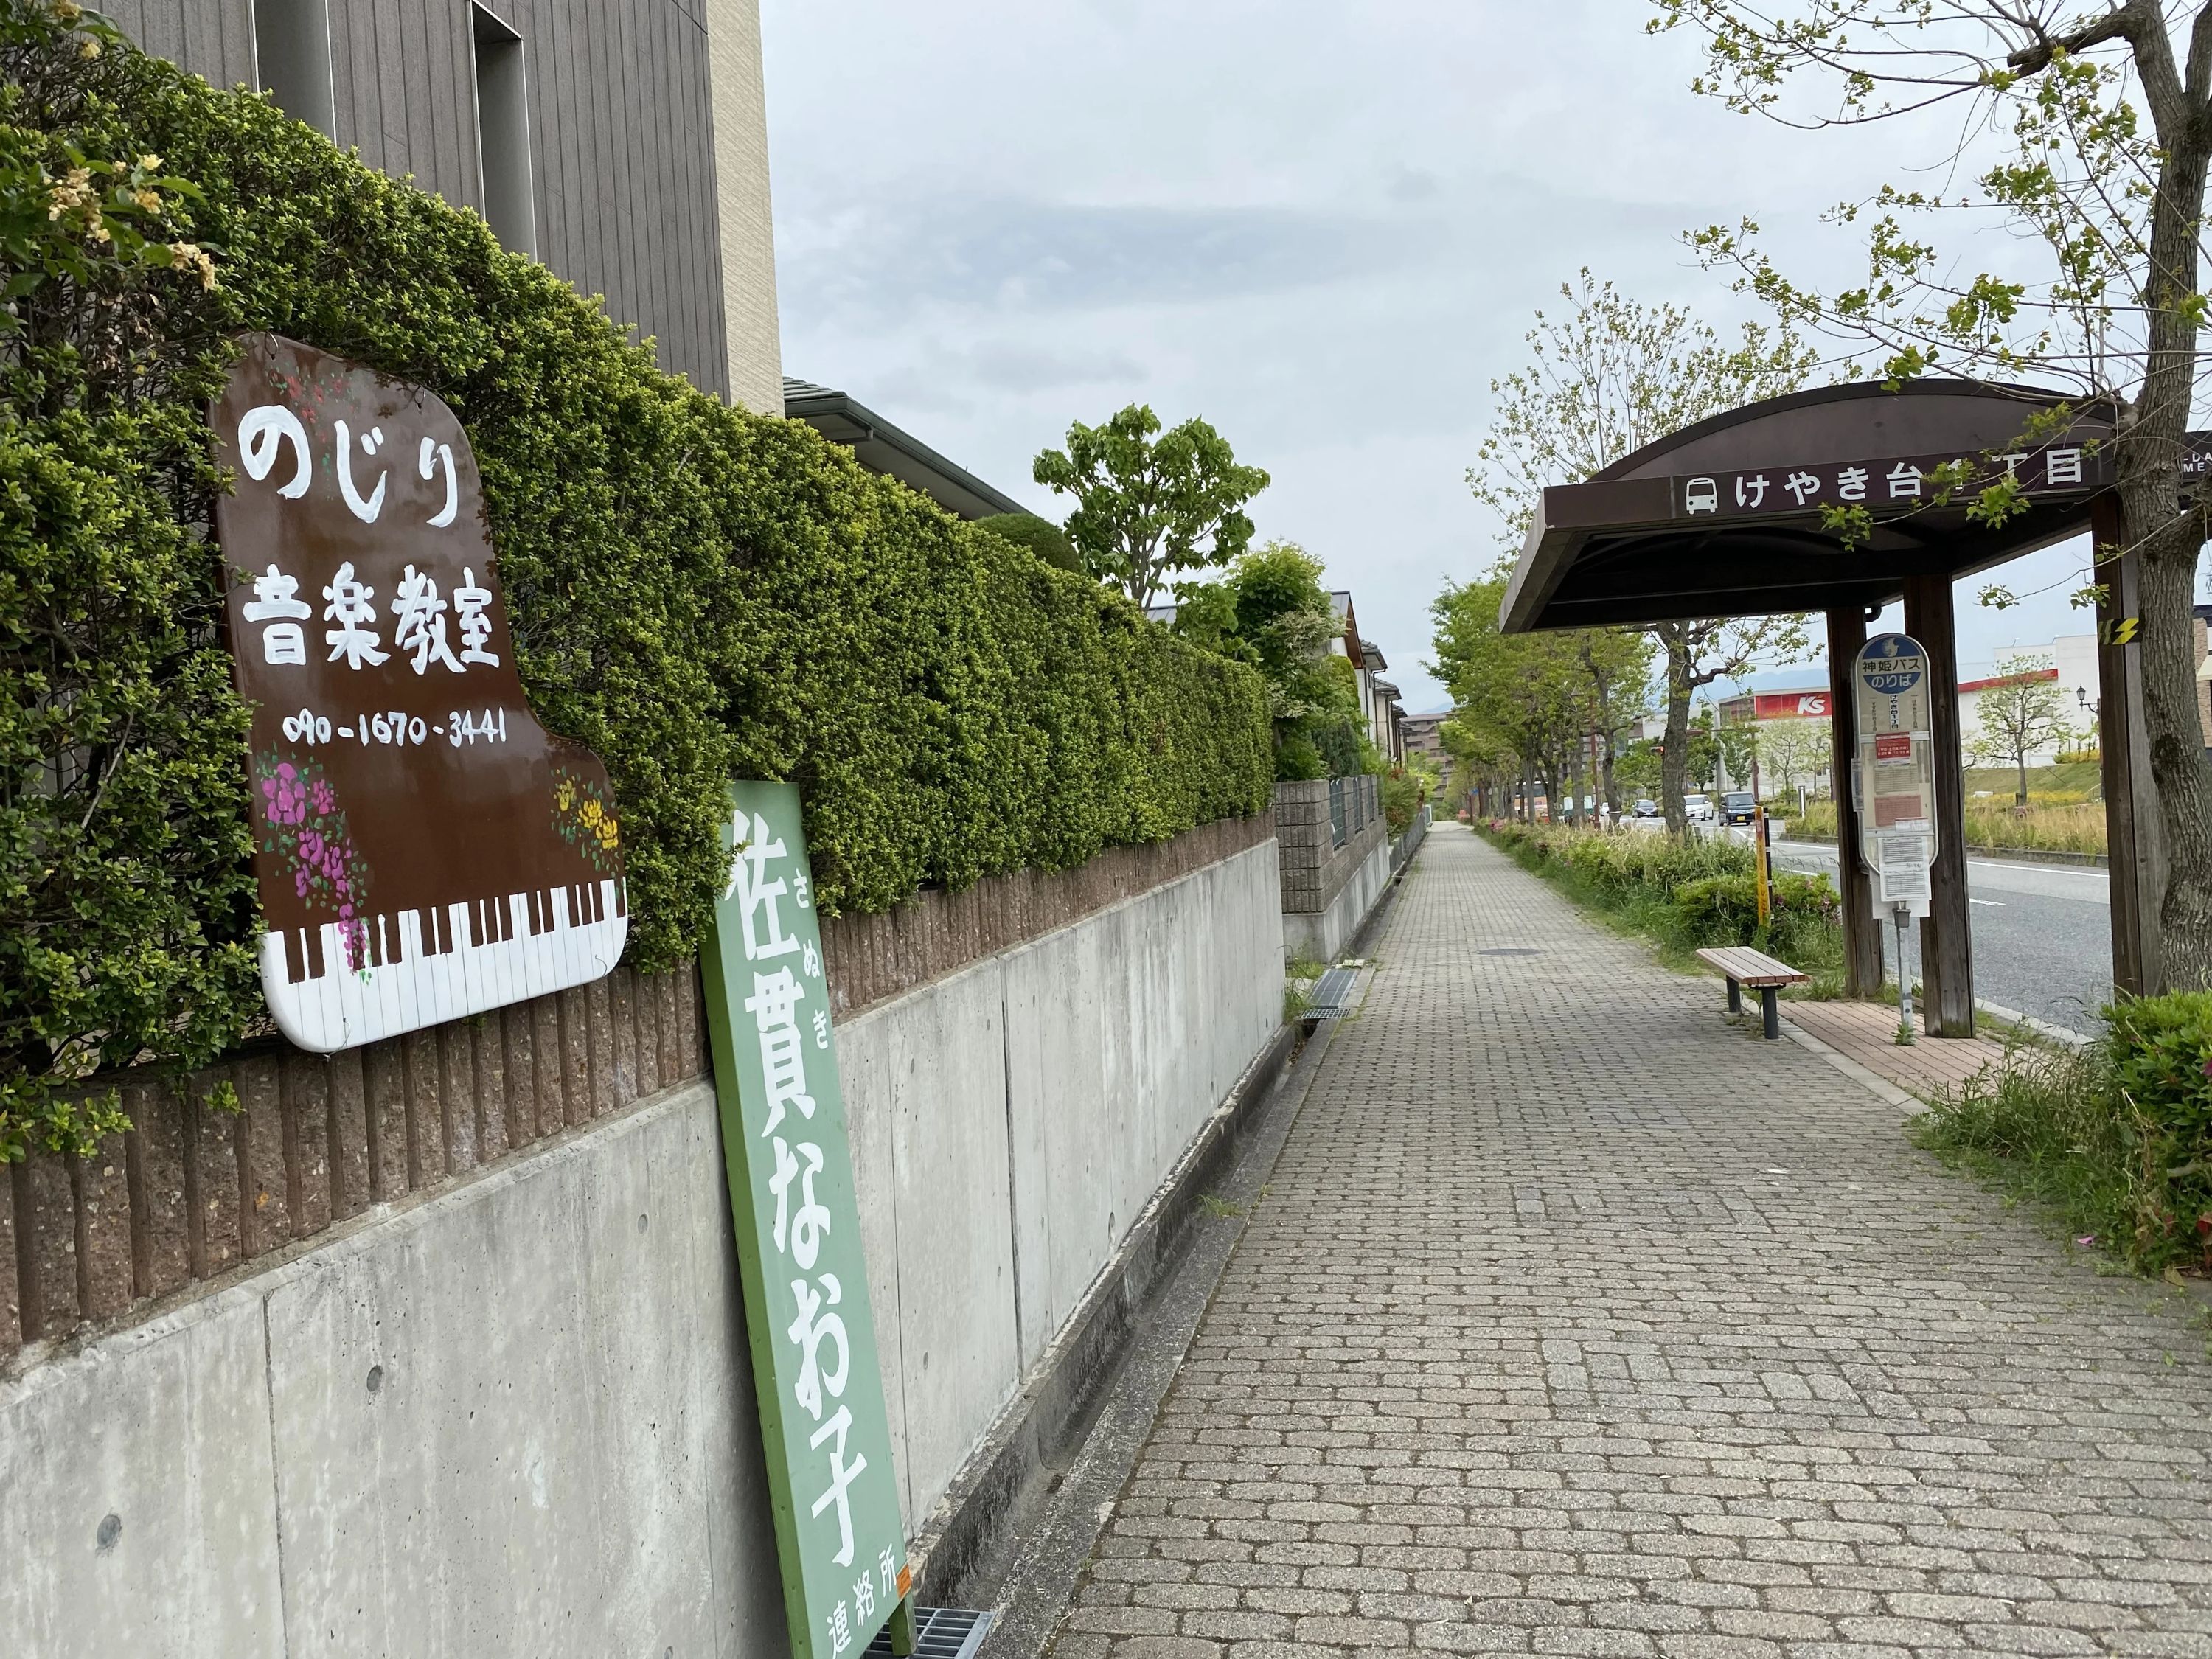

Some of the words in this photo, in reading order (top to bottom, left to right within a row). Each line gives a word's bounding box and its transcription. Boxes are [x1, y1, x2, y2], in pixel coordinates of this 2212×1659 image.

[238, 404, 458, 528] のじり
[243, 561, 500, 675] 音楽教室
[1862, 658, 1921, 673] 神姫バス
[282, 707, 507, 746] 090-1670-3441
[1871, 674, 1913, 688] のりば
[793, 867, 829, 1050] さぬき
[725, 810, 867, 1567] 佐貫なお子
[827, 1543, 897, 1659] 連絡所
